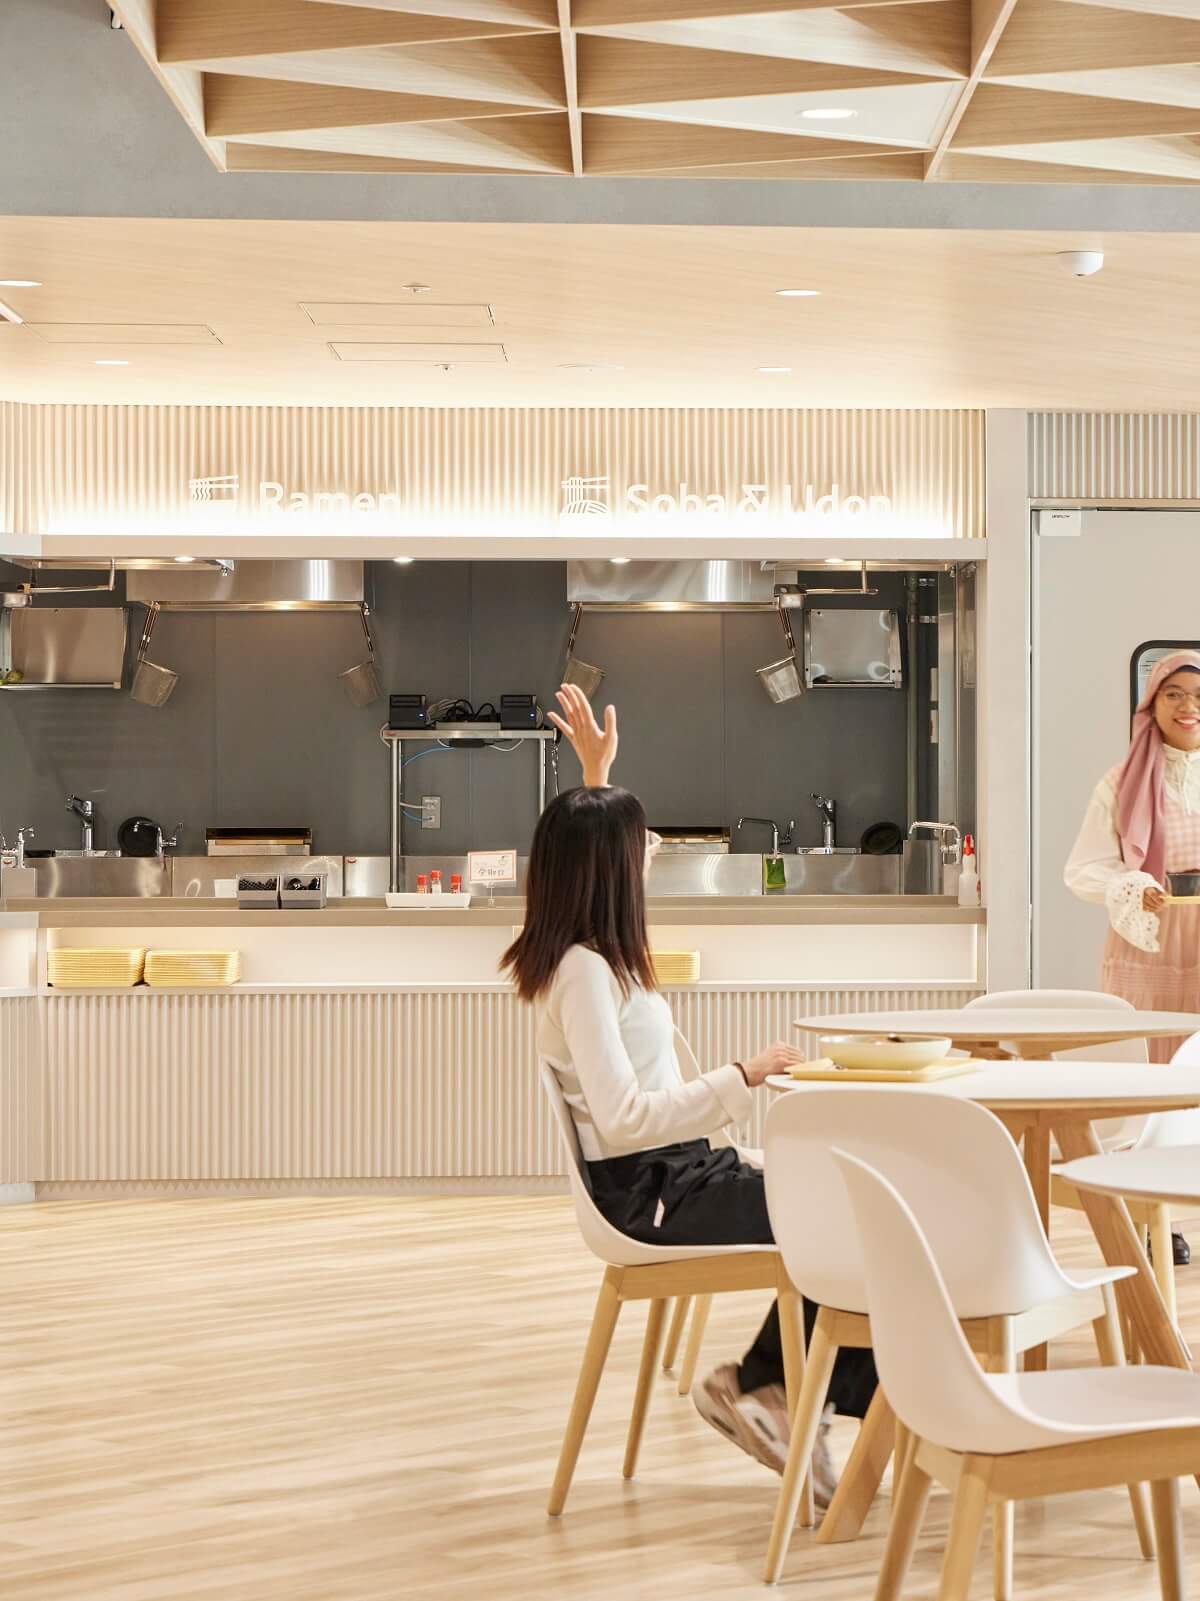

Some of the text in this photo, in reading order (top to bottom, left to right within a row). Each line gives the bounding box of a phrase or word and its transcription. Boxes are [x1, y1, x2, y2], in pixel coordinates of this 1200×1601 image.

[259, 482, 401, 518] Ramen
[627, 483, 892, 518] Soba & Udon
